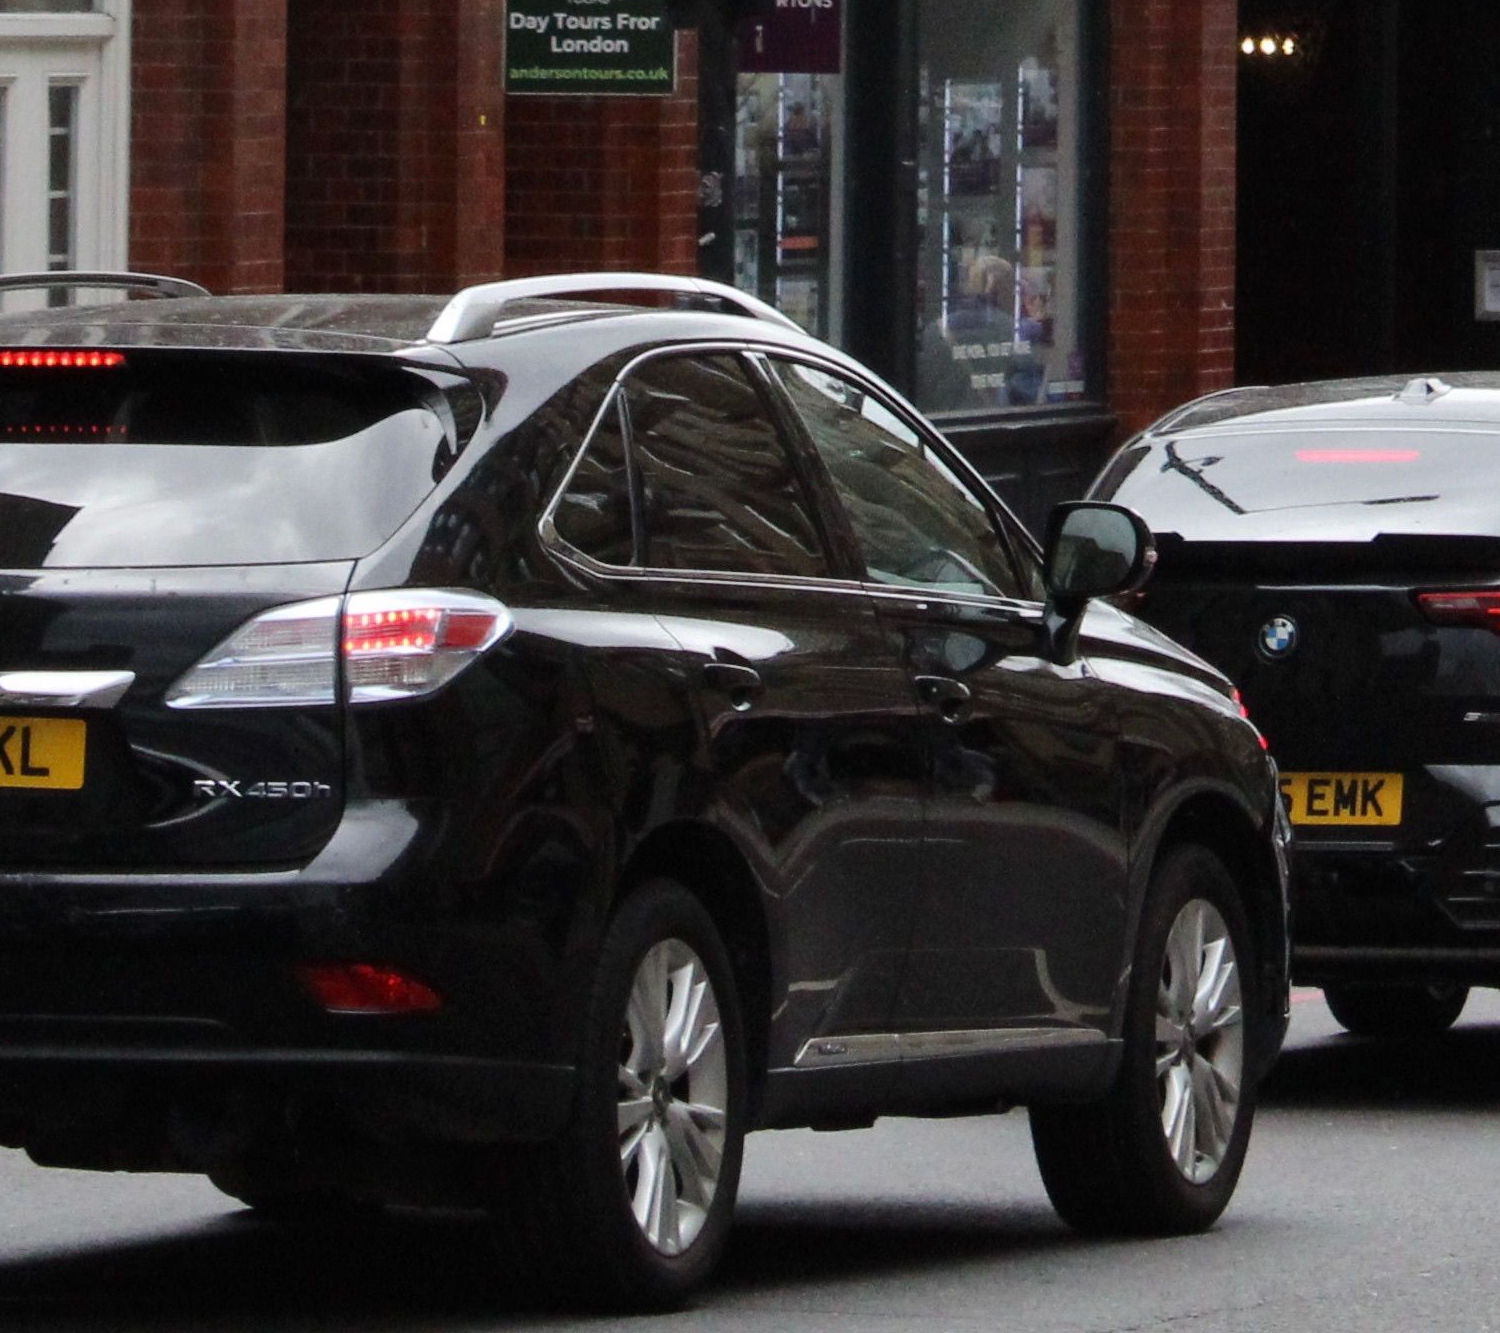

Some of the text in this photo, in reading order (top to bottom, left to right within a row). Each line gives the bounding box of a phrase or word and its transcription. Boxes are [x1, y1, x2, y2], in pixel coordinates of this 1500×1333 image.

[509, 12, 549, 34] Day
[553, 13, 612, 31] Tours
[551, 35, 629, 54] London
[509, 66, 669, 81] andersontours.co.uk
[194, 780, 332, 798] RX 450h
[1306, 779, 1385, 817] EMK
